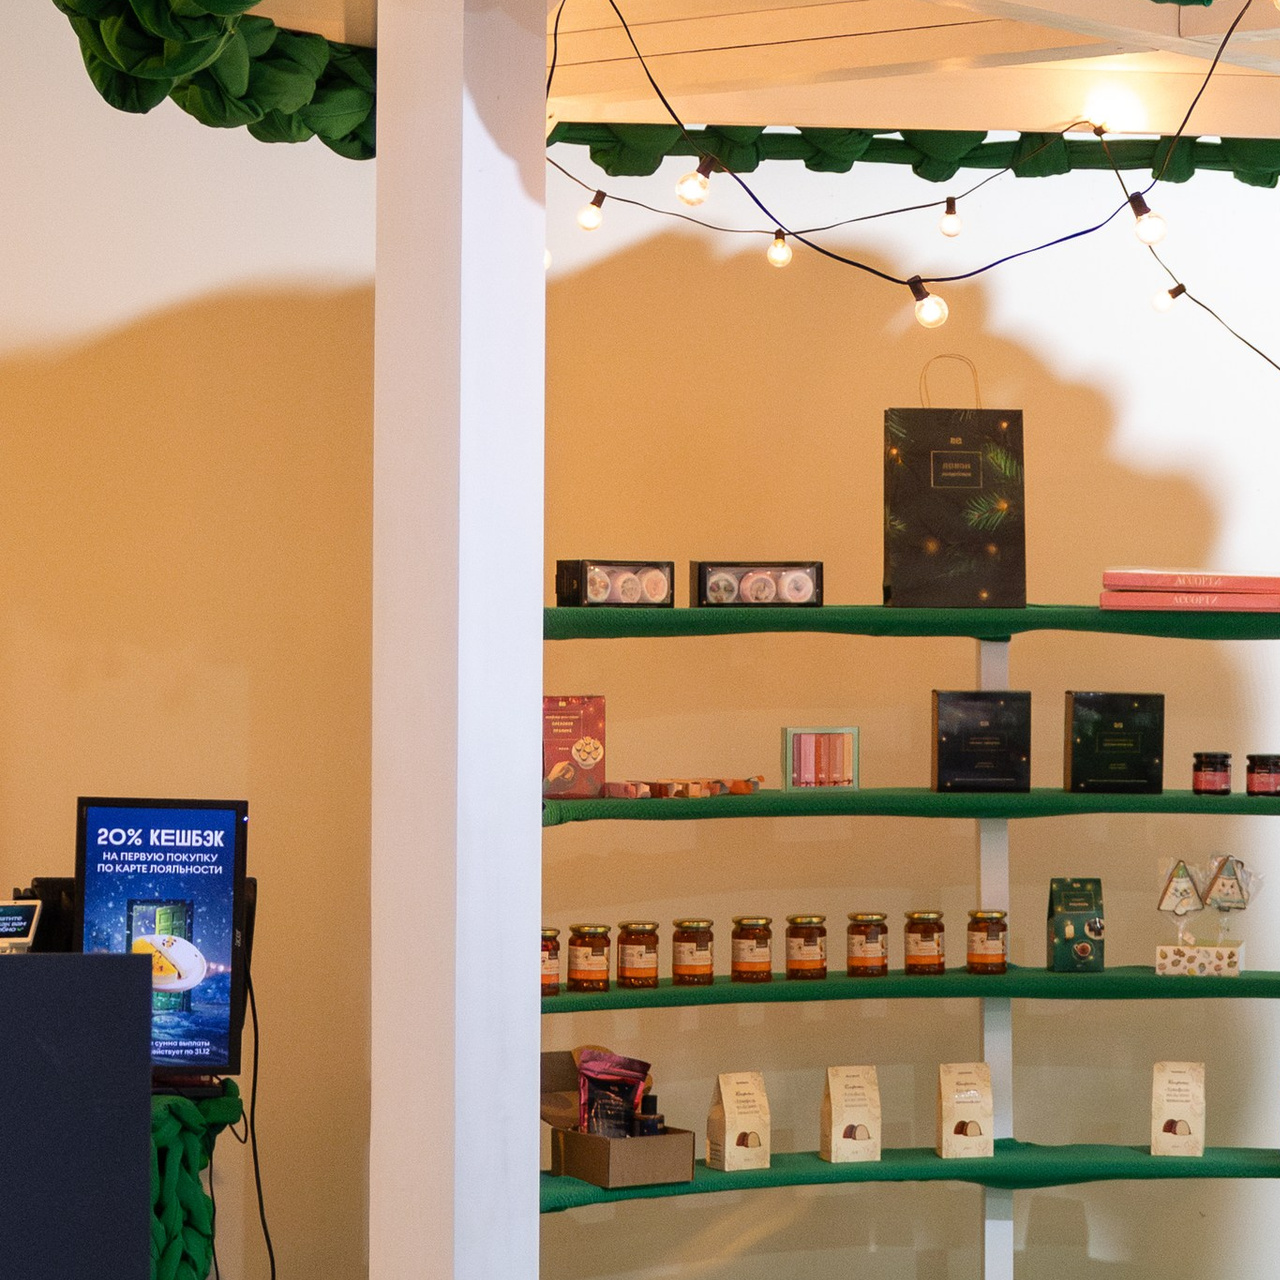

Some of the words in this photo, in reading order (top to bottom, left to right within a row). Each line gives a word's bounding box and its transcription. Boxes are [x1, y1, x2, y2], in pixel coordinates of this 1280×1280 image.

[97, 828, 143, 846] 20%
[150, 829, 225, 847] КЕШБЭК
[103, 852, 118, 861] НА
[120, 852, 164, 862] ПЕРВУЮ
[166, 853, 218, 863] ПОКУПКУ
[97, 864, 113, 873] ПО
[115, 864, 147, 873] КАРТЕ
[149, 864, 223, 874] ЛОЯЛЬНОСТИ
